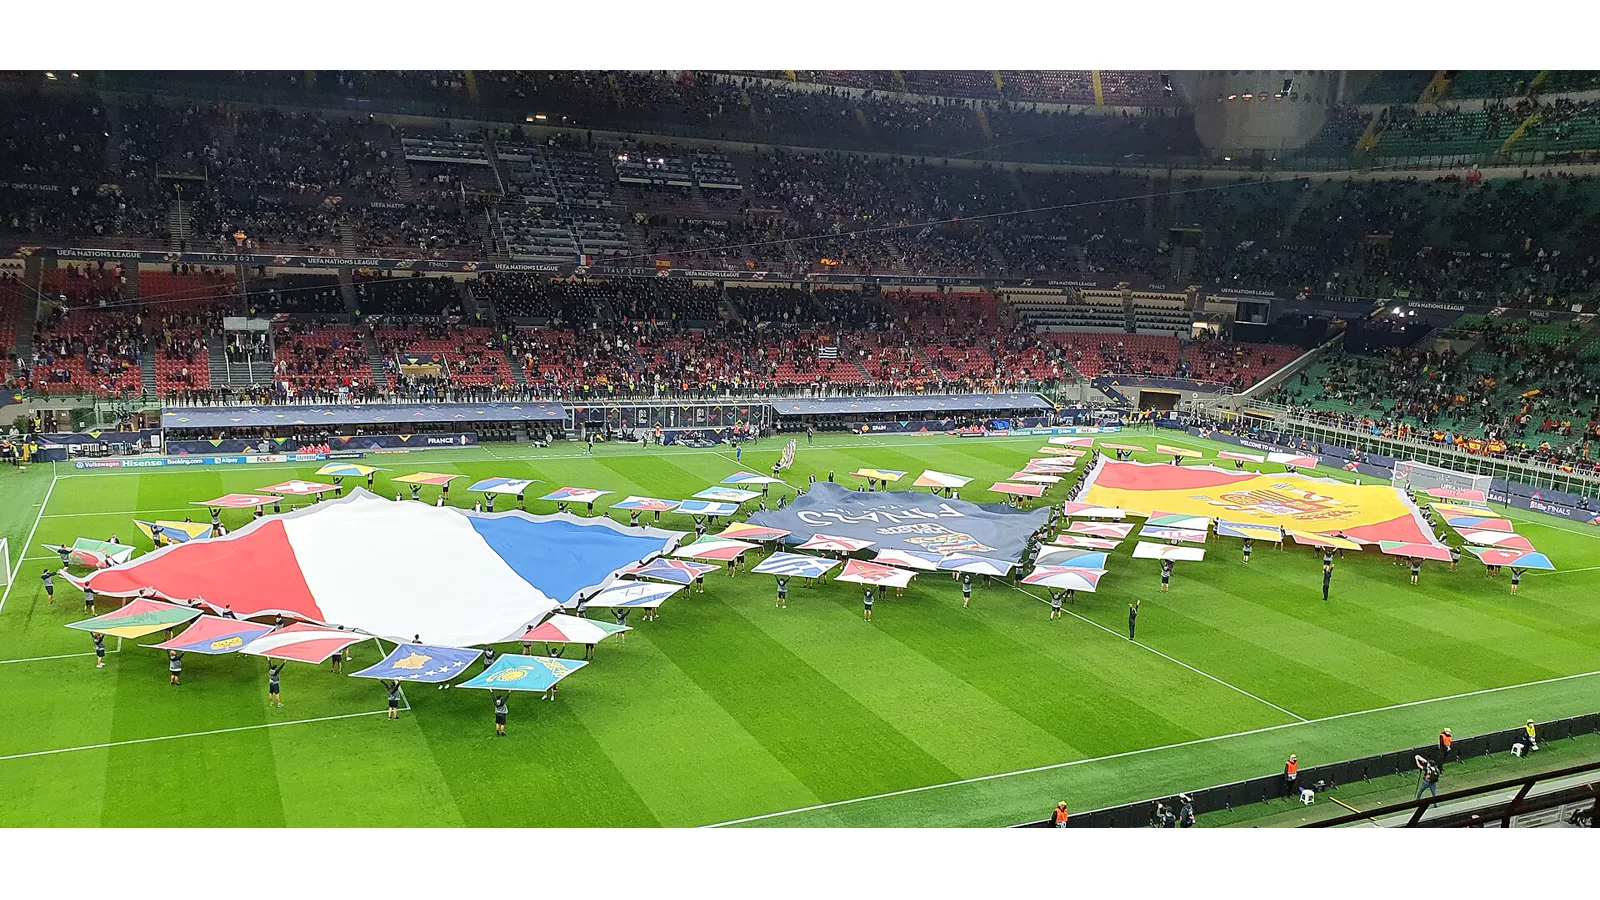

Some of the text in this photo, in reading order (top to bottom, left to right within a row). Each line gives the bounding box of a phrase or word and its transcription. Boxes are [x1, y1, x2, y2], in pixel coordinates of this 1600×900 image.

[112, 251, 141, 259] LEAGUE
[511, 264, 536, 272] NATIONS
[536, 265, 559, 273] LEAGUE
[1443, 304, 1465, 312] LEAGUE
[1529, 310, 1550, 318] FINALS
[871, 424, 887, 432] SPAIN
[427, 437, 454, 445] FRANCE
[1239, 439, 1261, 450] WELCOME
[84, 461, 120, 469] Volkswagen
[122, 458, 163, 468] Hisense
[166, 458, 203, 466] Booking.com
[1547, 504, 1572, 516] FINALS
